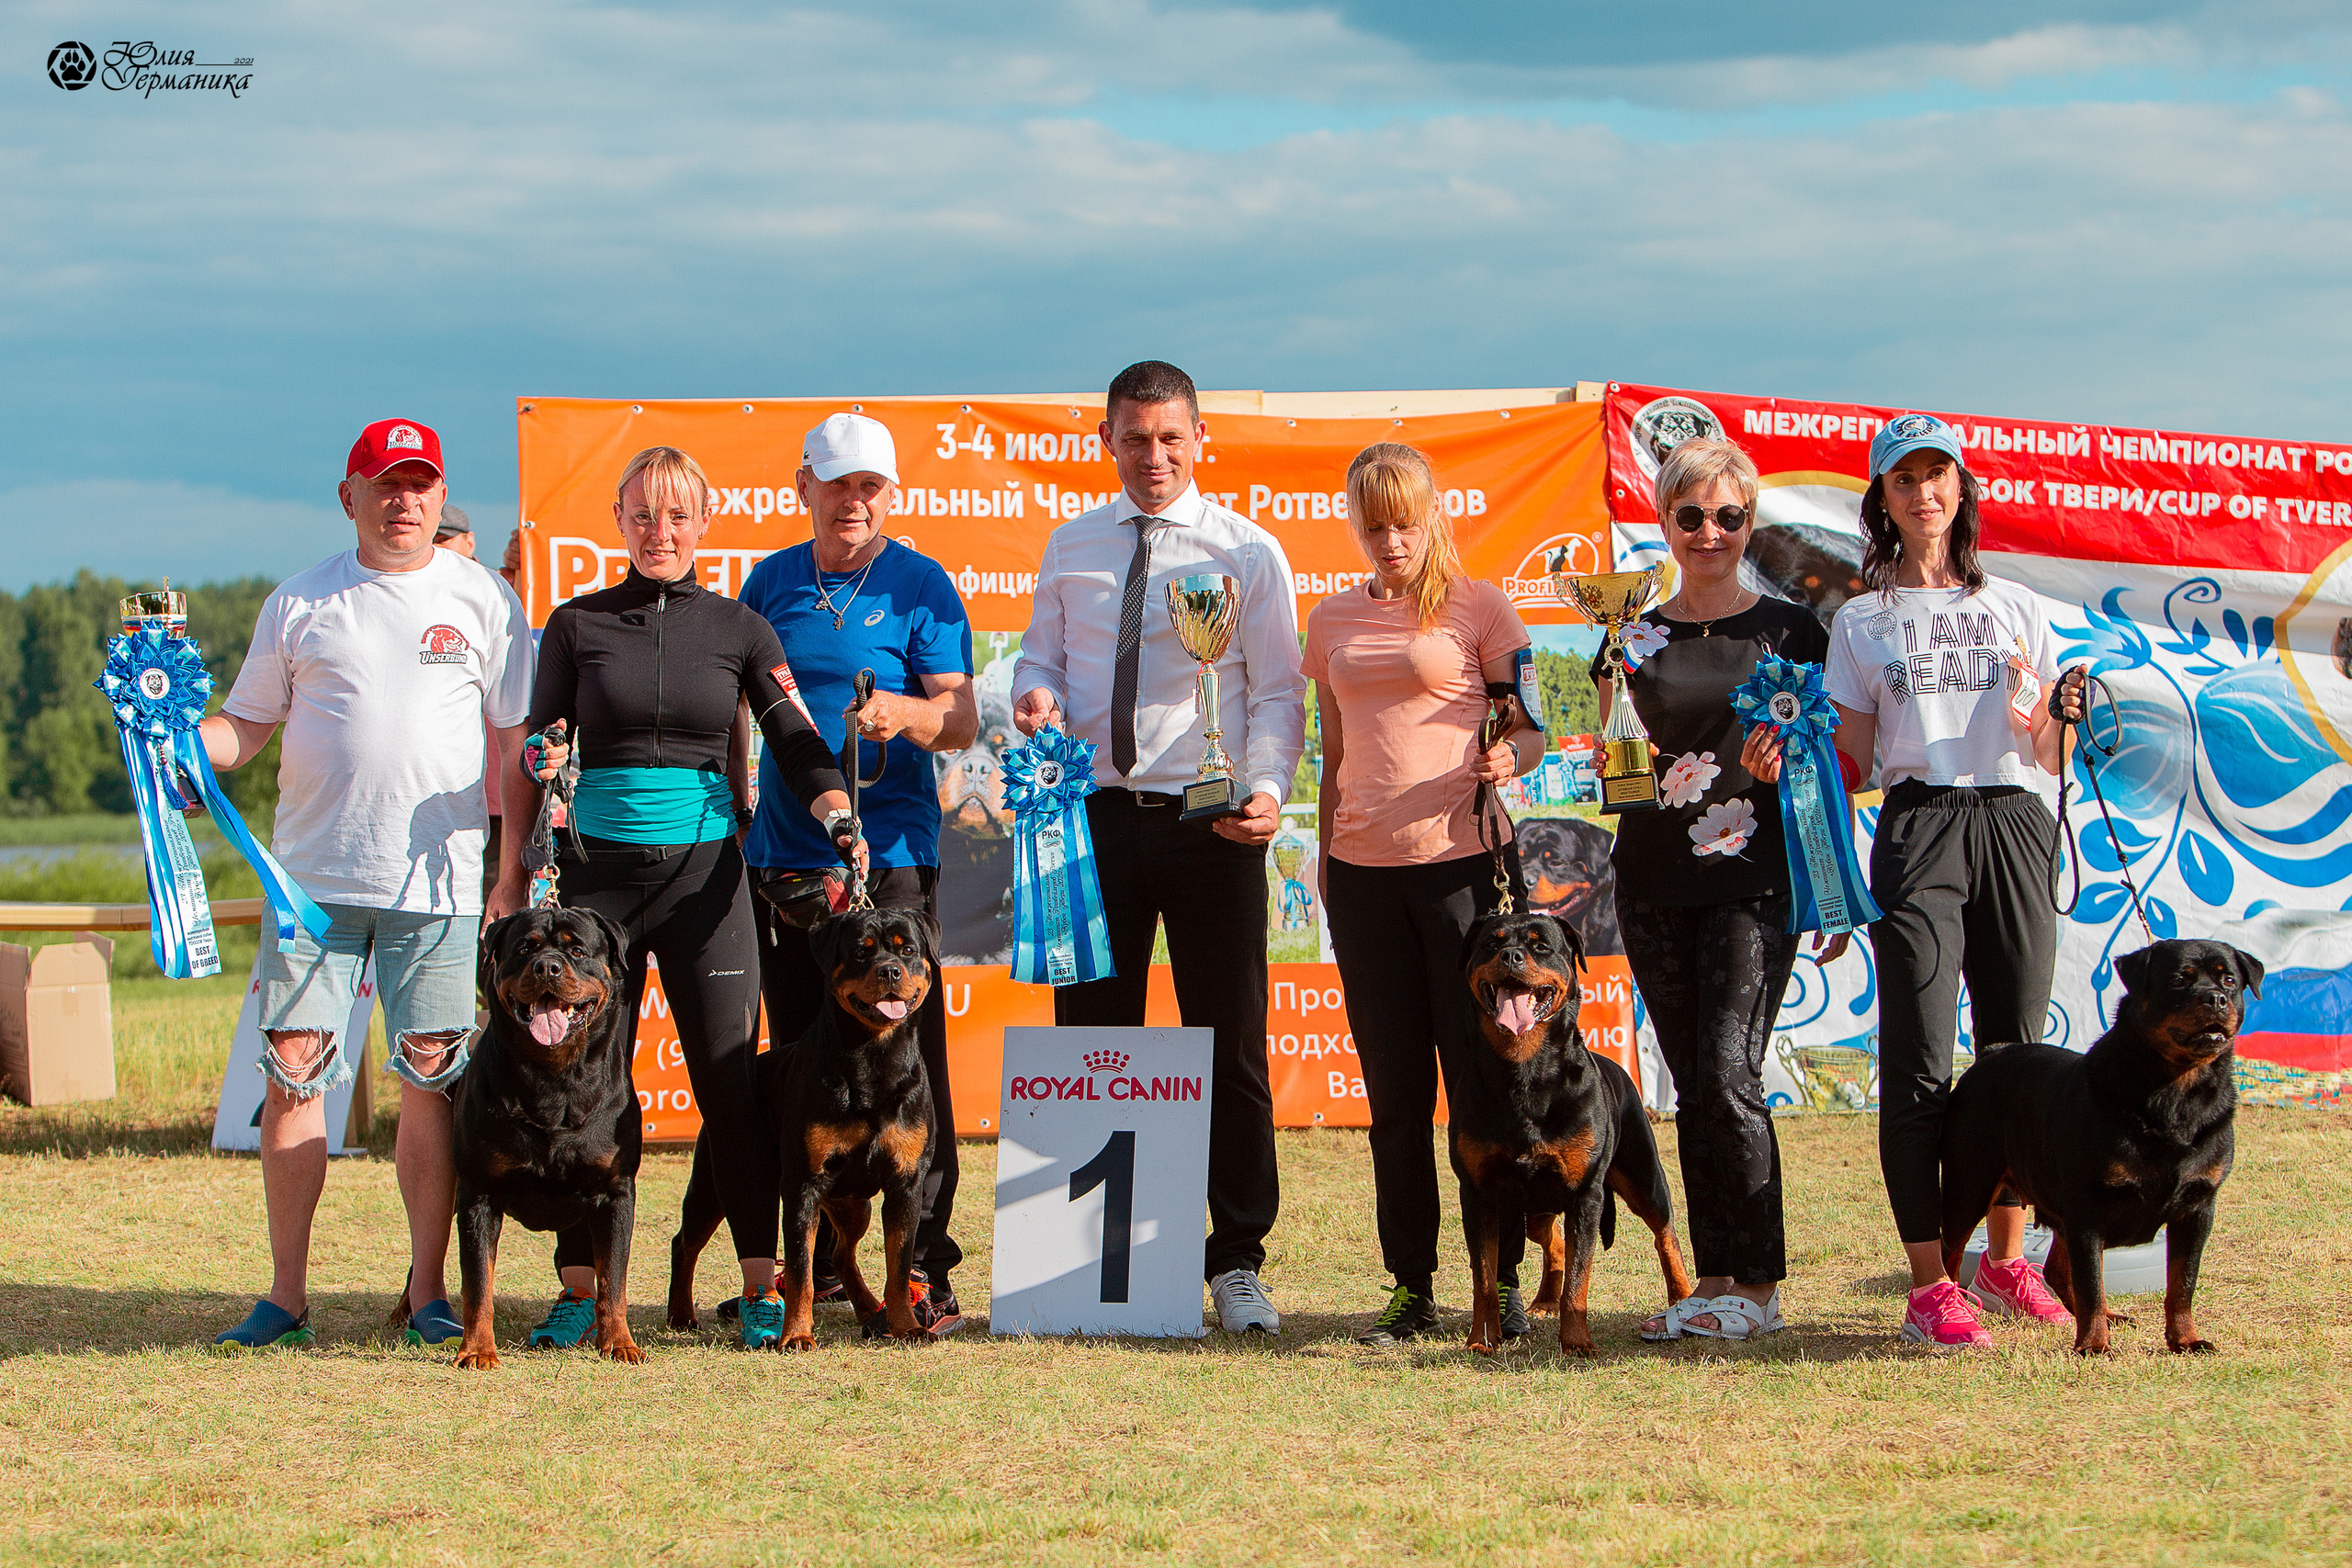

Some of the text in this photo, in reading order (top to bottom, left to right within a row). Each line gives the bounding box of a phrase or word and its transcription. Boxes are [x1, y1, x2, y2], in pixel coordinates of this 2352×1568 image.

[935, 423, 995, 460] 3-4
[1005, 433, 1102, 462] июля
[2100, 434, 2307, 472] ЧЕМПИОНАТ
[1975, 476, 2352, 527] БОК ТВЕРИ/CUP OF TVER
[1903, 612, 1998, 653] I AM
[1883, 649, 2024, 706] READY
[1793, 765, 1814, 778] РКФ
[1041, 829, 1061, 840] РКФ
[1813, 869, 1820, 879] 23
[1825, 909, 1843, 919] BEST
[1823, 918, 1849, 929] FEMALE
[195, 945, 209, 956] BEST
[191, 955, 219, 969] OF BREED
[1054, 967, 1071, 976] BEST
[1051, 976, 1076, 985] JUNIOR
[1011, 1077, 1202, 1101] ROYAL CANIN
[1069, 1130, 1136, 1304] 1
